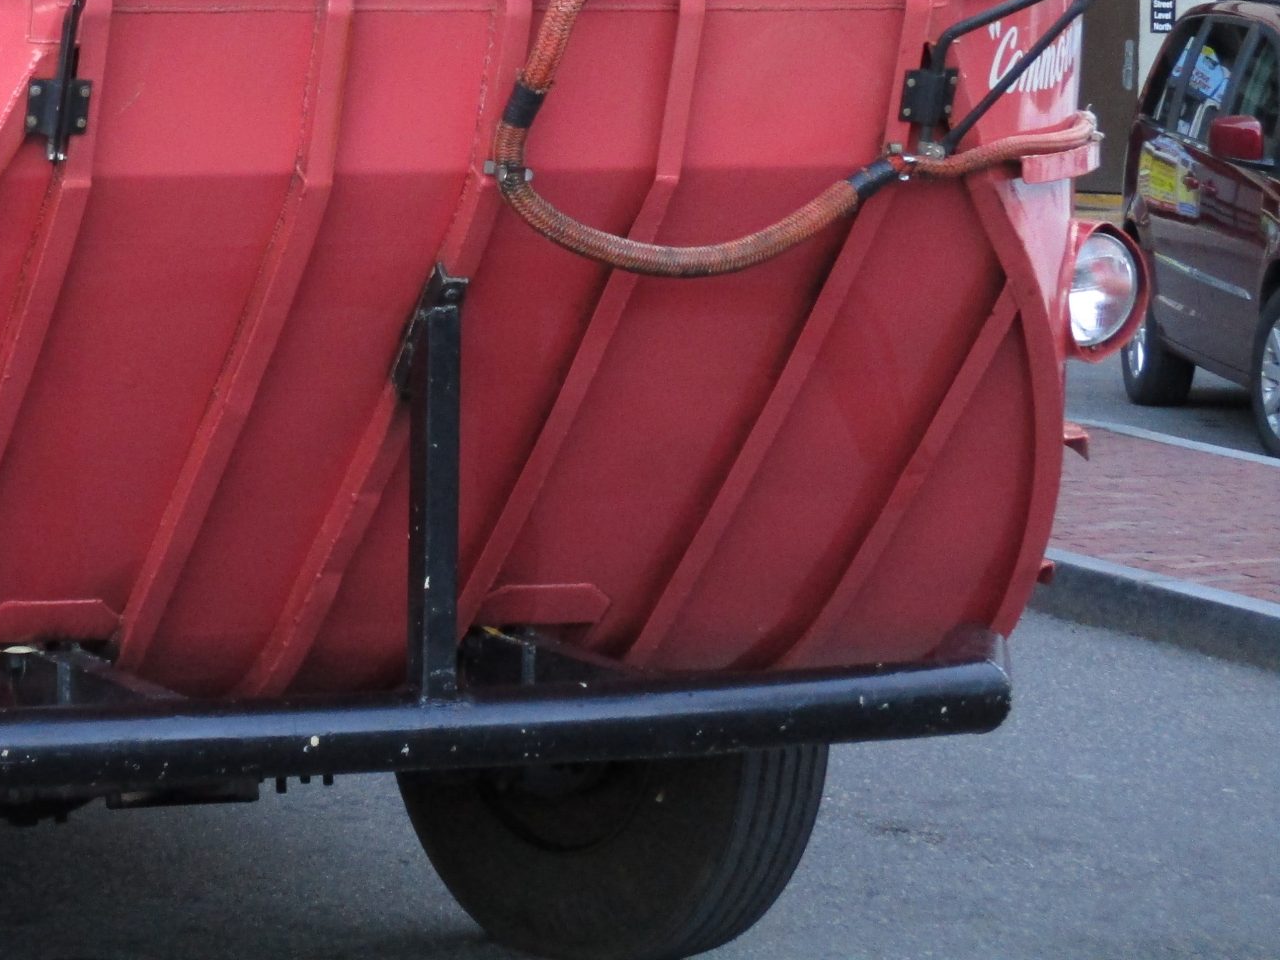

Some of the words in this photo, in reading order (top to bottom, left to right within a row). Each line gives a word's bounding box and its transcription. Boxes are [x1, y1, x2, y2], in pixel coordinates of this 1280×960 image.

[1153, 0, 1173, 9] Street
[1153, 11, 1172, 20] Level
[1153, 22, 1172, 31] North
